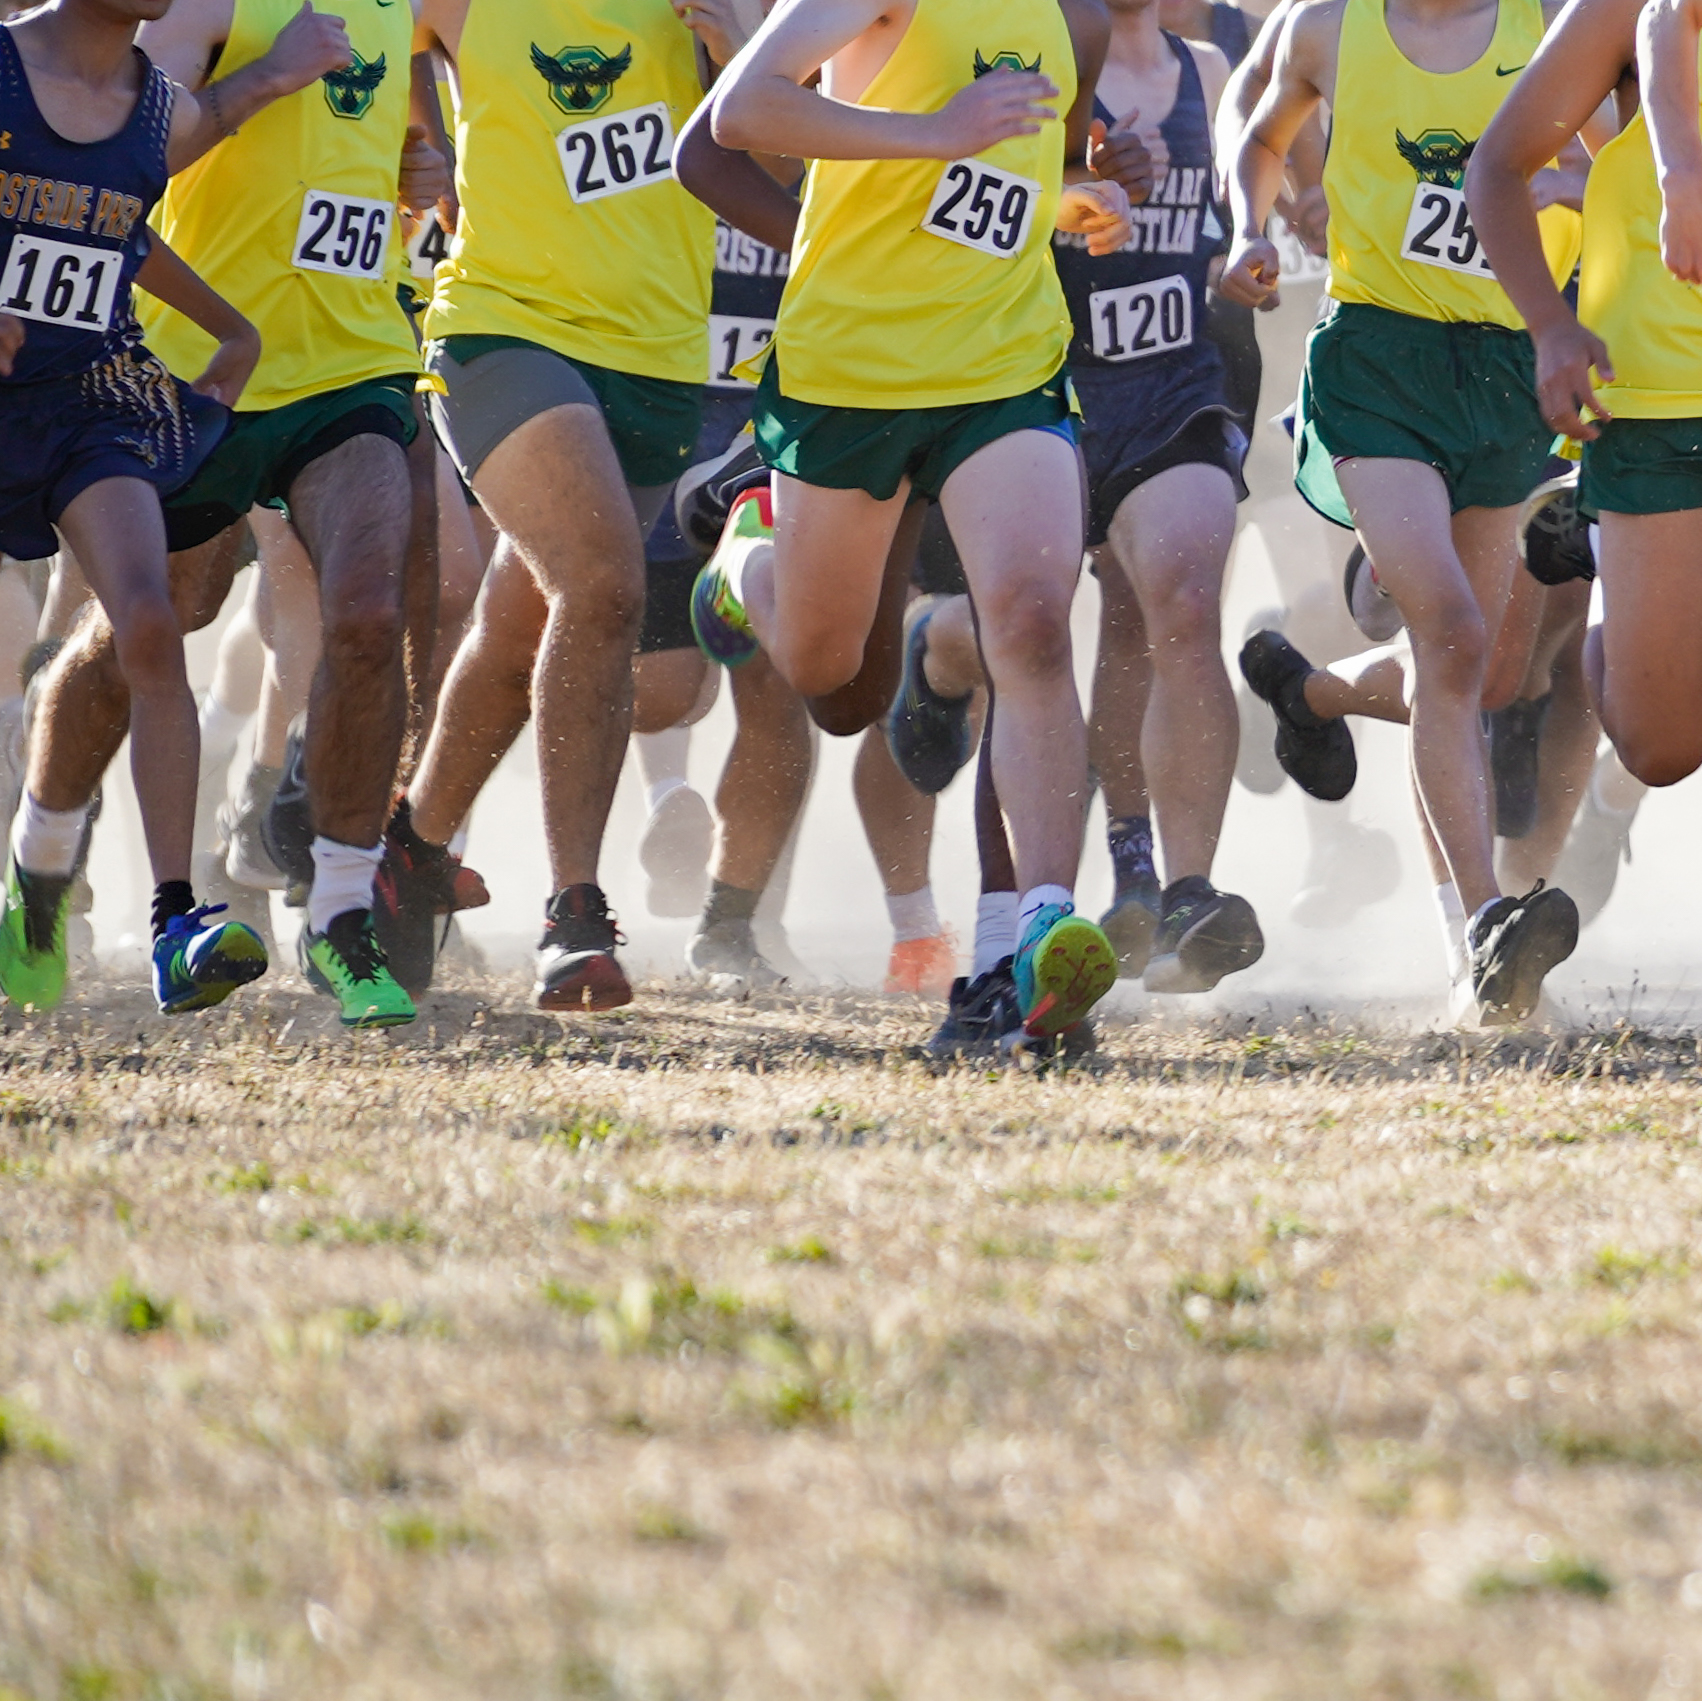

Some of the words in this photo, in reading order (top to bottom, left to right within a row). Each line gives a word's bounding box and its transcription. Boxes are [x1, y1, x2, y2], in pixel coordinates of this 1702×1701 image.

[565, 113, 671, 194] 262
[299, 199, 386, 271] 256
[931, 163, 1029, 250] 259
[1409, 193, 1492, 271] 25
[7, 248, 106, 324] 161
[1101, 286, 1184, 357] 120
